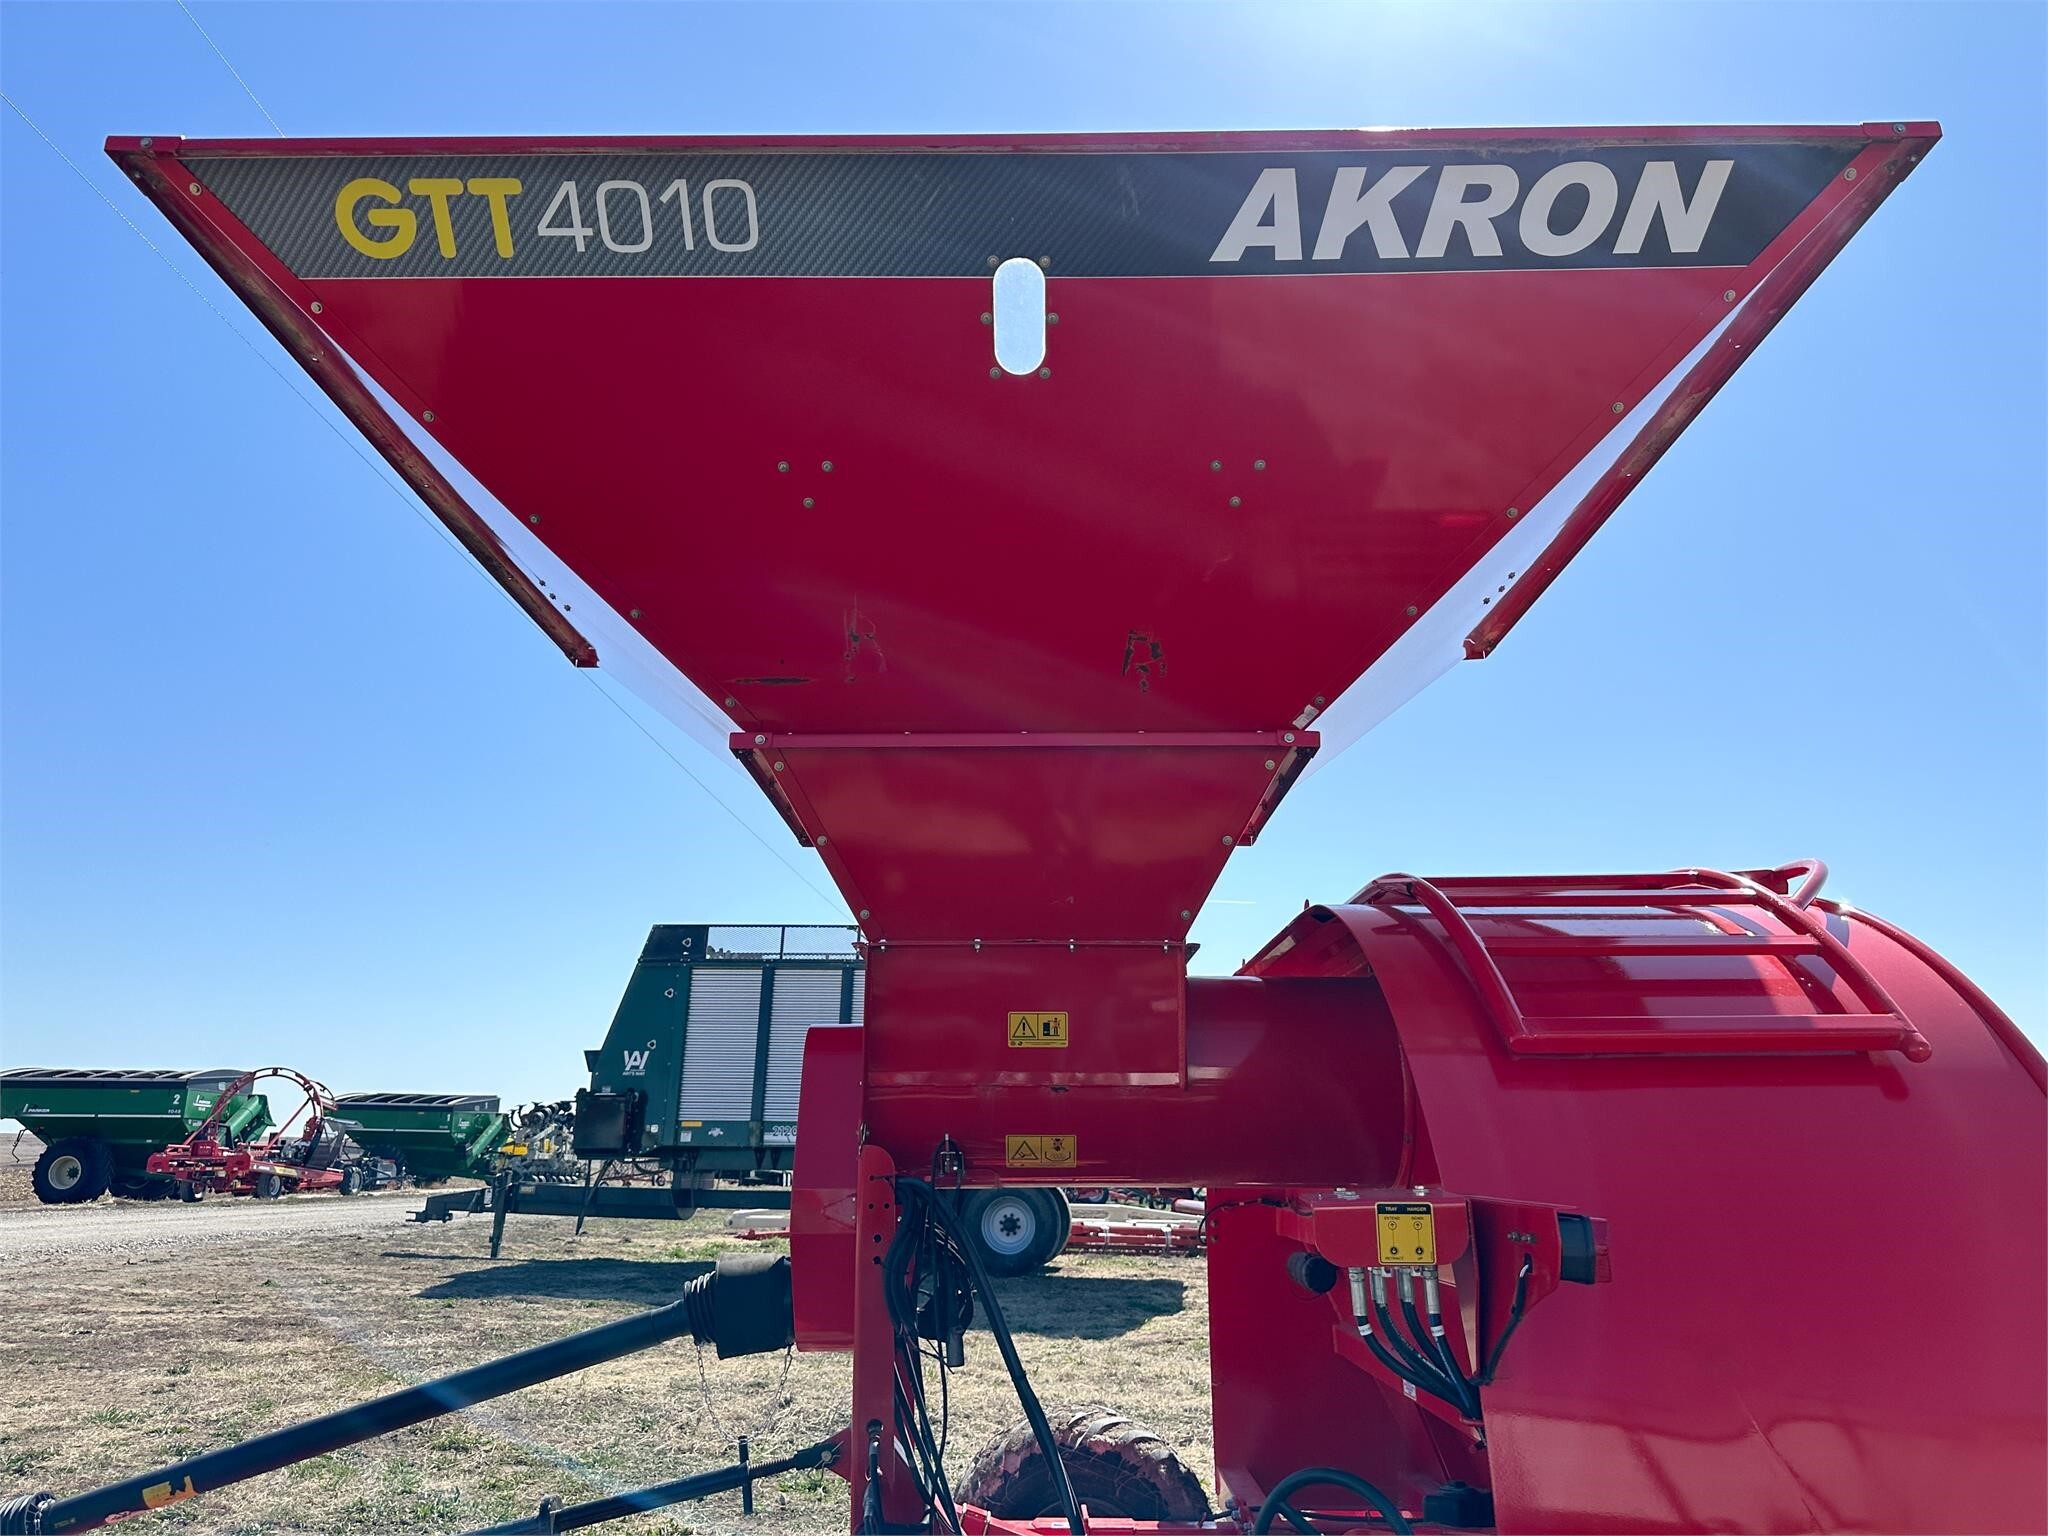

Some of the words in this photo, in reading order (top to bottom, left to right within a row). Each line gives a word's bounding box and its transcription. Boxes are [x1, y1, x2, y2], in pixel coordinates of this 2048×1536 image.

[335, 178, 522, 259] GTT
[537, 179, 759, 253] 4010
[1209, 160, 1735, 262] AKRON
[173, 1094, 181, 1105] 2
